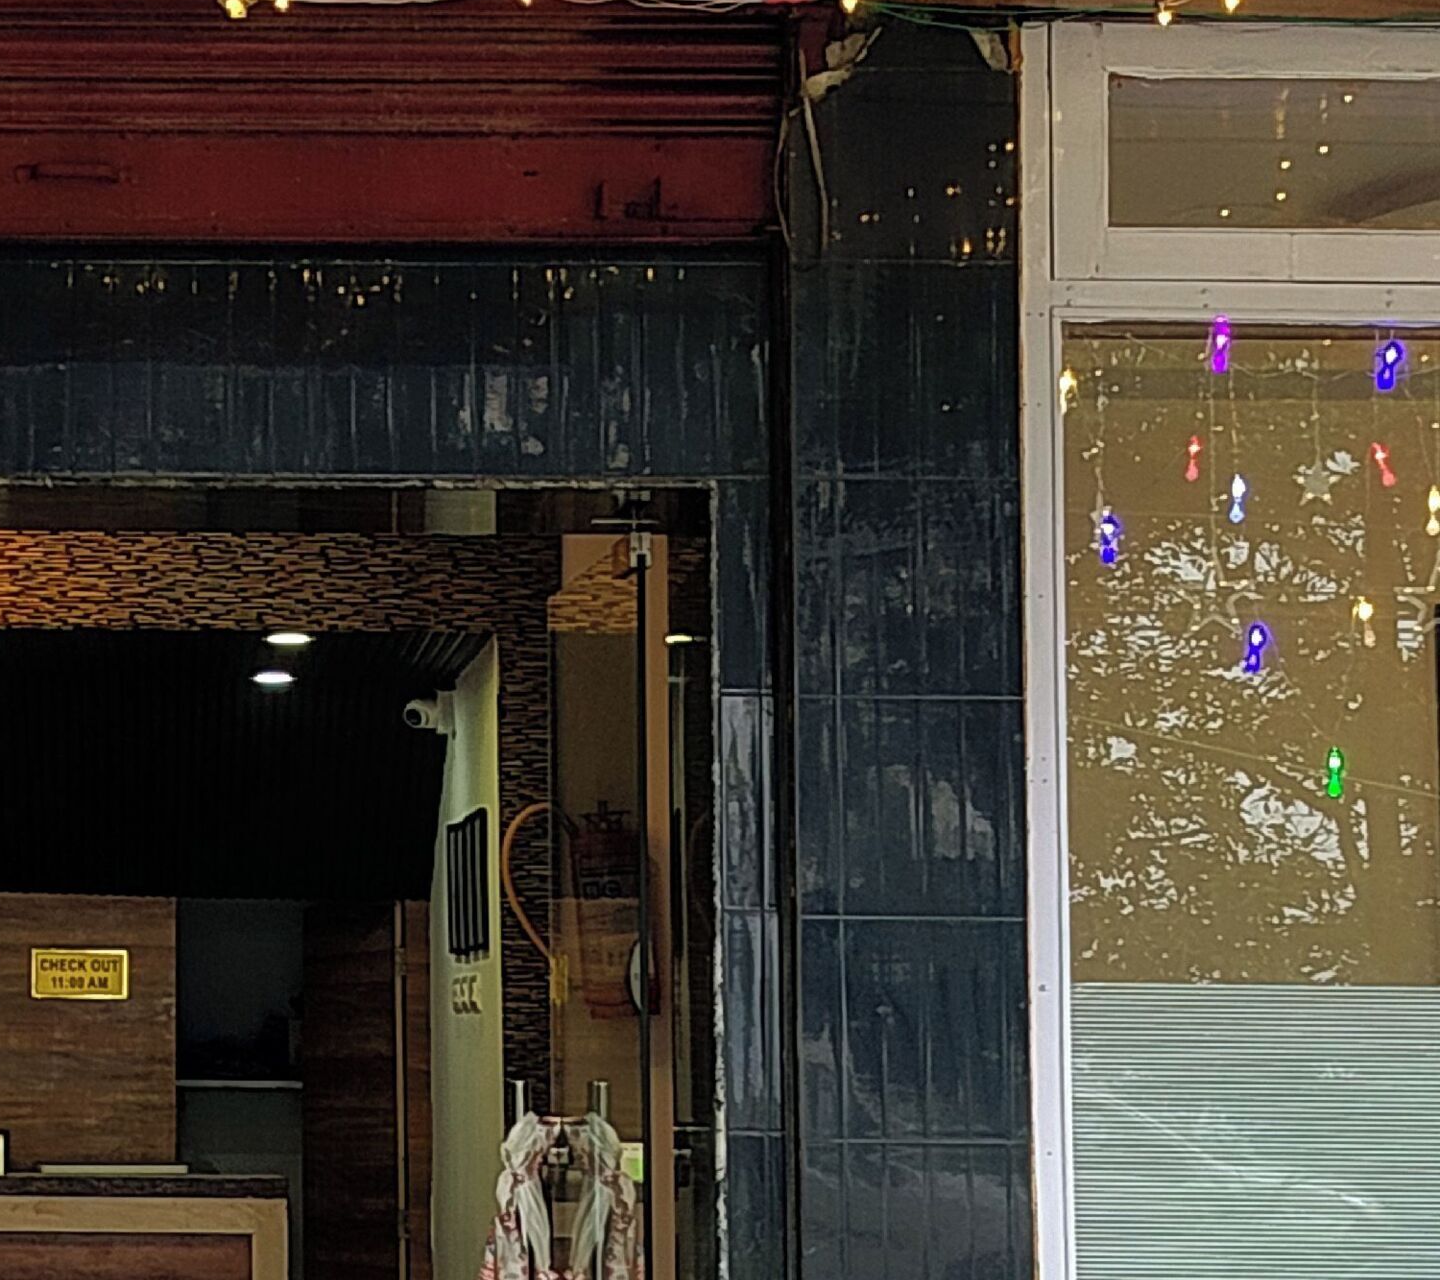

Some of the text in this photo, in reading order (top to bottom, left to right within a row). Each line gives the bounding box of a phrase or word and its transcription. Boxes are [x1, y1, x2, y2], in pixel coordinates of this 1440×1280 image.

[39, 957, 120, 974] CHECK OUT
[87, 976, 109, 989] AM
